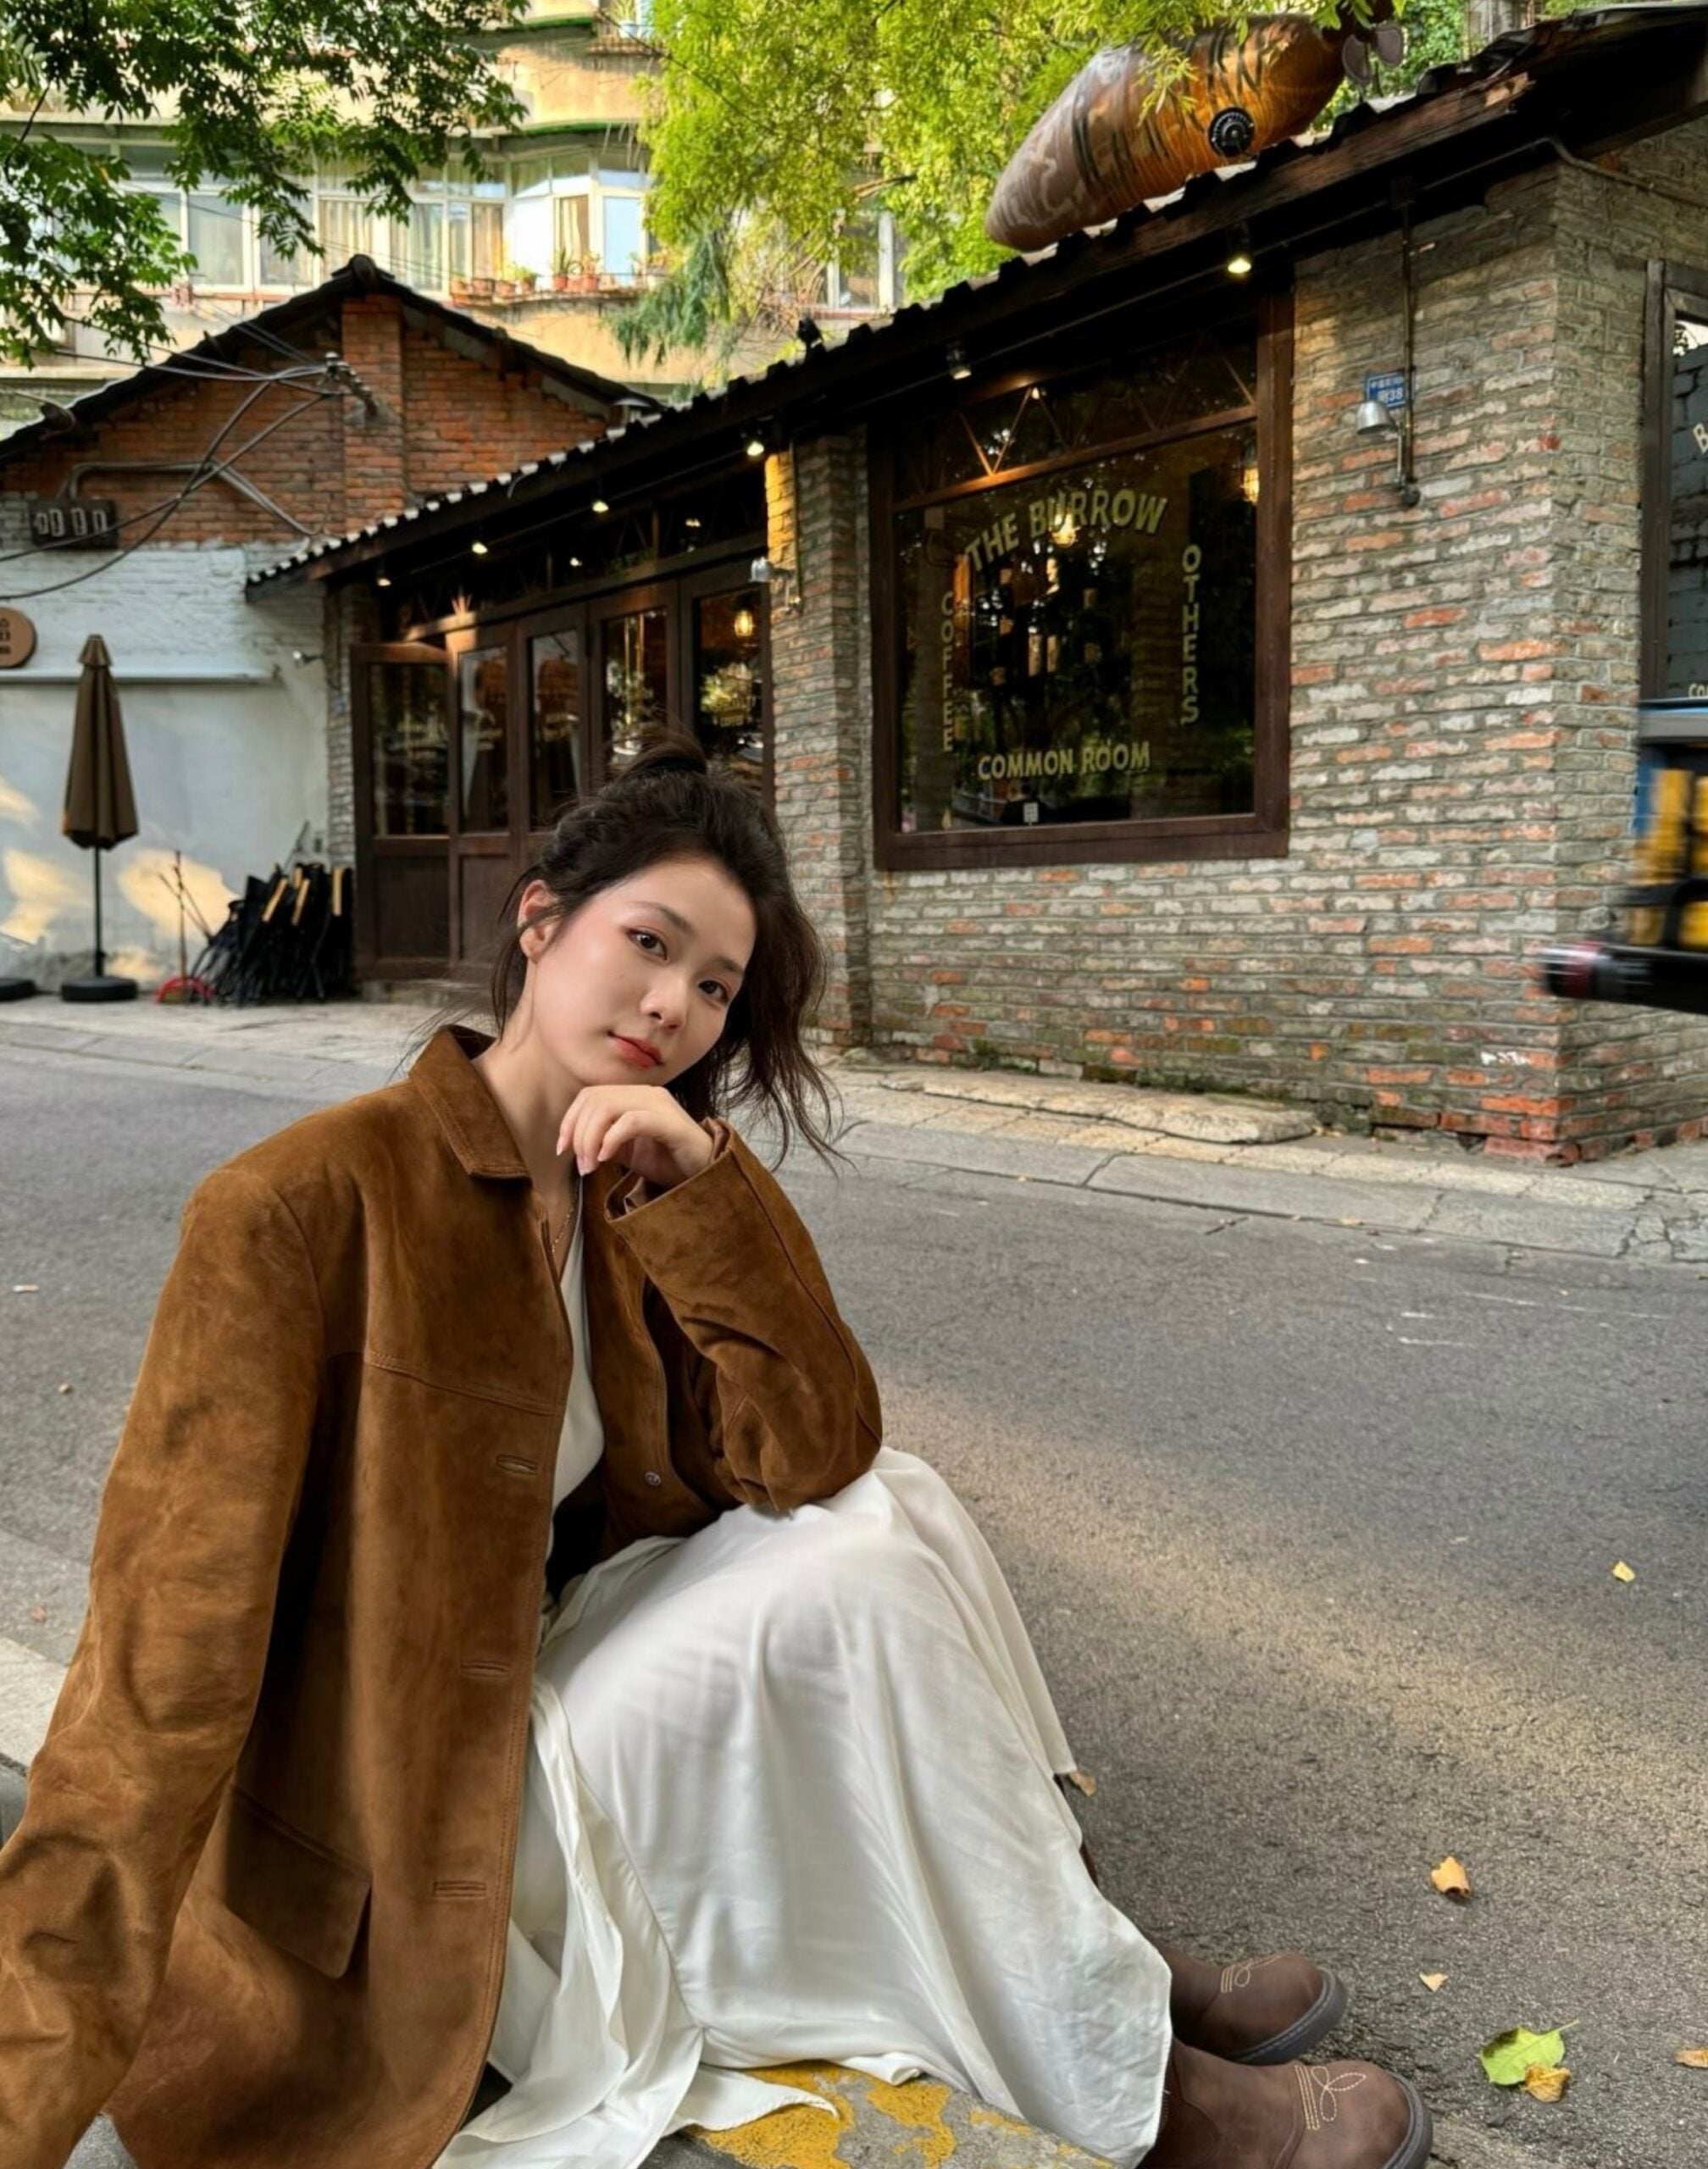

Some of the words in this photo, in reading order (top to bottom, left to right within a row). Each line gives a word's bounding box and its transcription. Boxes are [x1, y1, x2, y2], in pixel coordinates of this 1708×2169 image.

[964, 513, 1019, 572] THE
[1029, 488, 1168, 538] BURROW
[940, 591, 955, 752] COFFEE
[1181, 544, 1201, 725] OTHERS
[978, 748, 1074, 780] COMMON
[1081, 741, 1151, 775] ROOM
